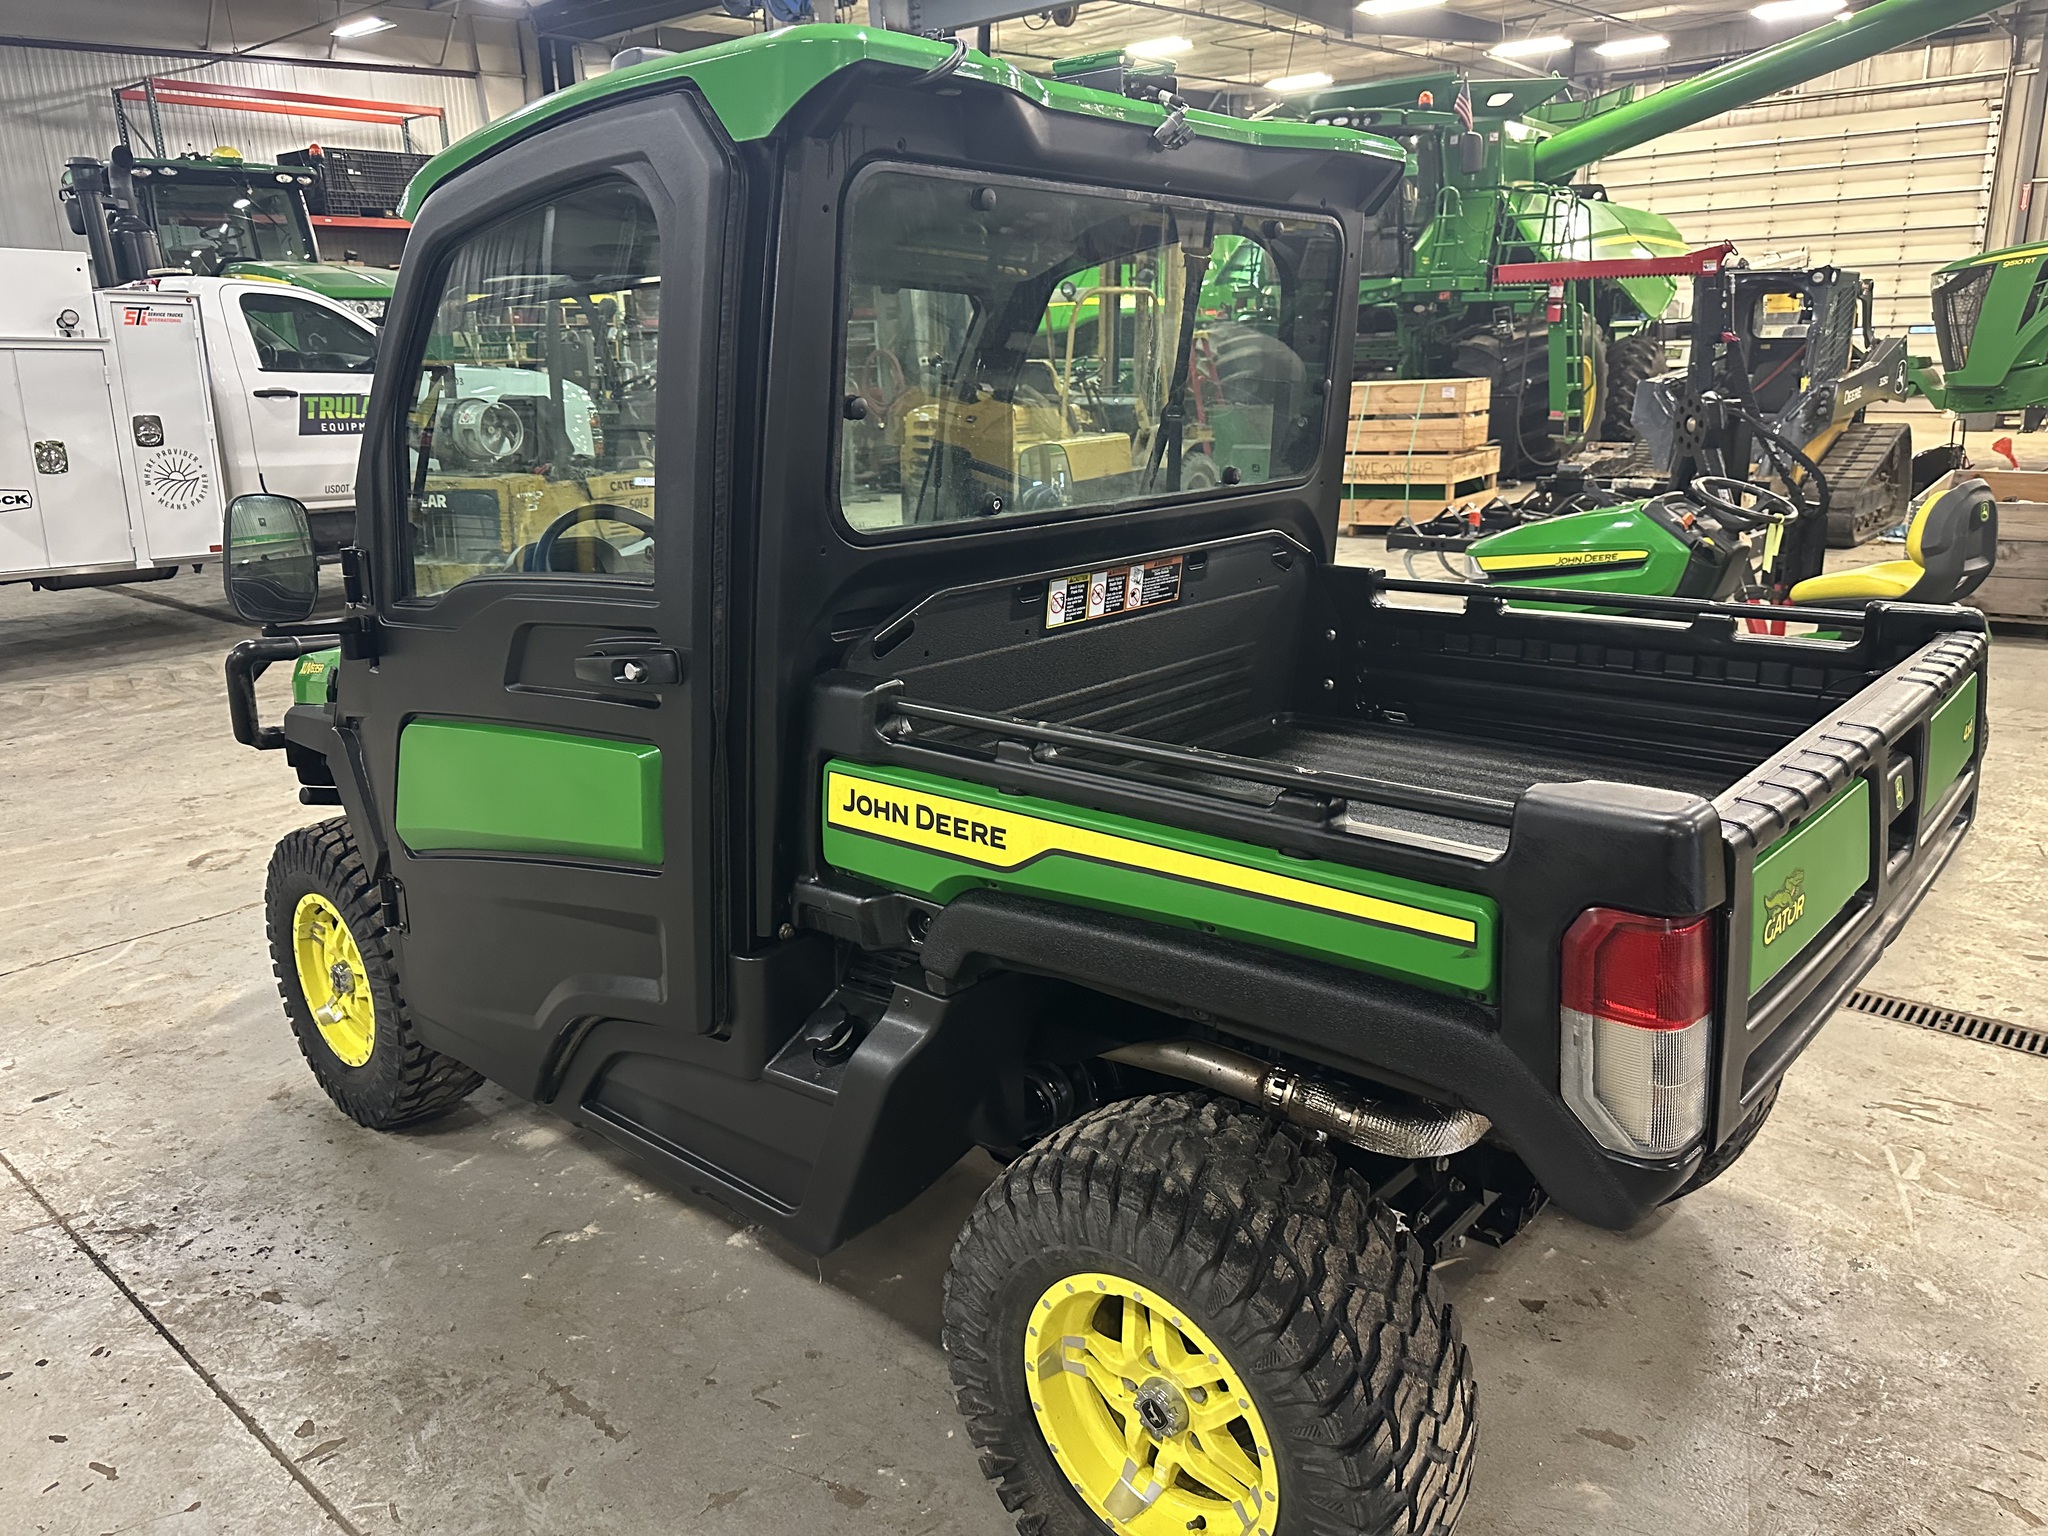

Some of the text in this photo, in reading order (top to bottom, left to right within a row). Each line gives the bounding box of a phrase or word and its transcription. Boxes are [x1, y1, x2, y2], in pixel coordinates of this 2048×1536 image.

[1843, 385, 1863, 405] DEERE
[144, 448, 199, 487] WHERE PROVIDER
[0, 494, 29, 506] CK
[158, 473, 209, 510] MEANS PARTNER
[324, 484, 350, 494] USDOT
[1555, 552, 1619, 565] JOHN DEERE
[843, 788, 1007, 851] JOHN DEERE
[1764, 893, 1806, 946] GATOR
